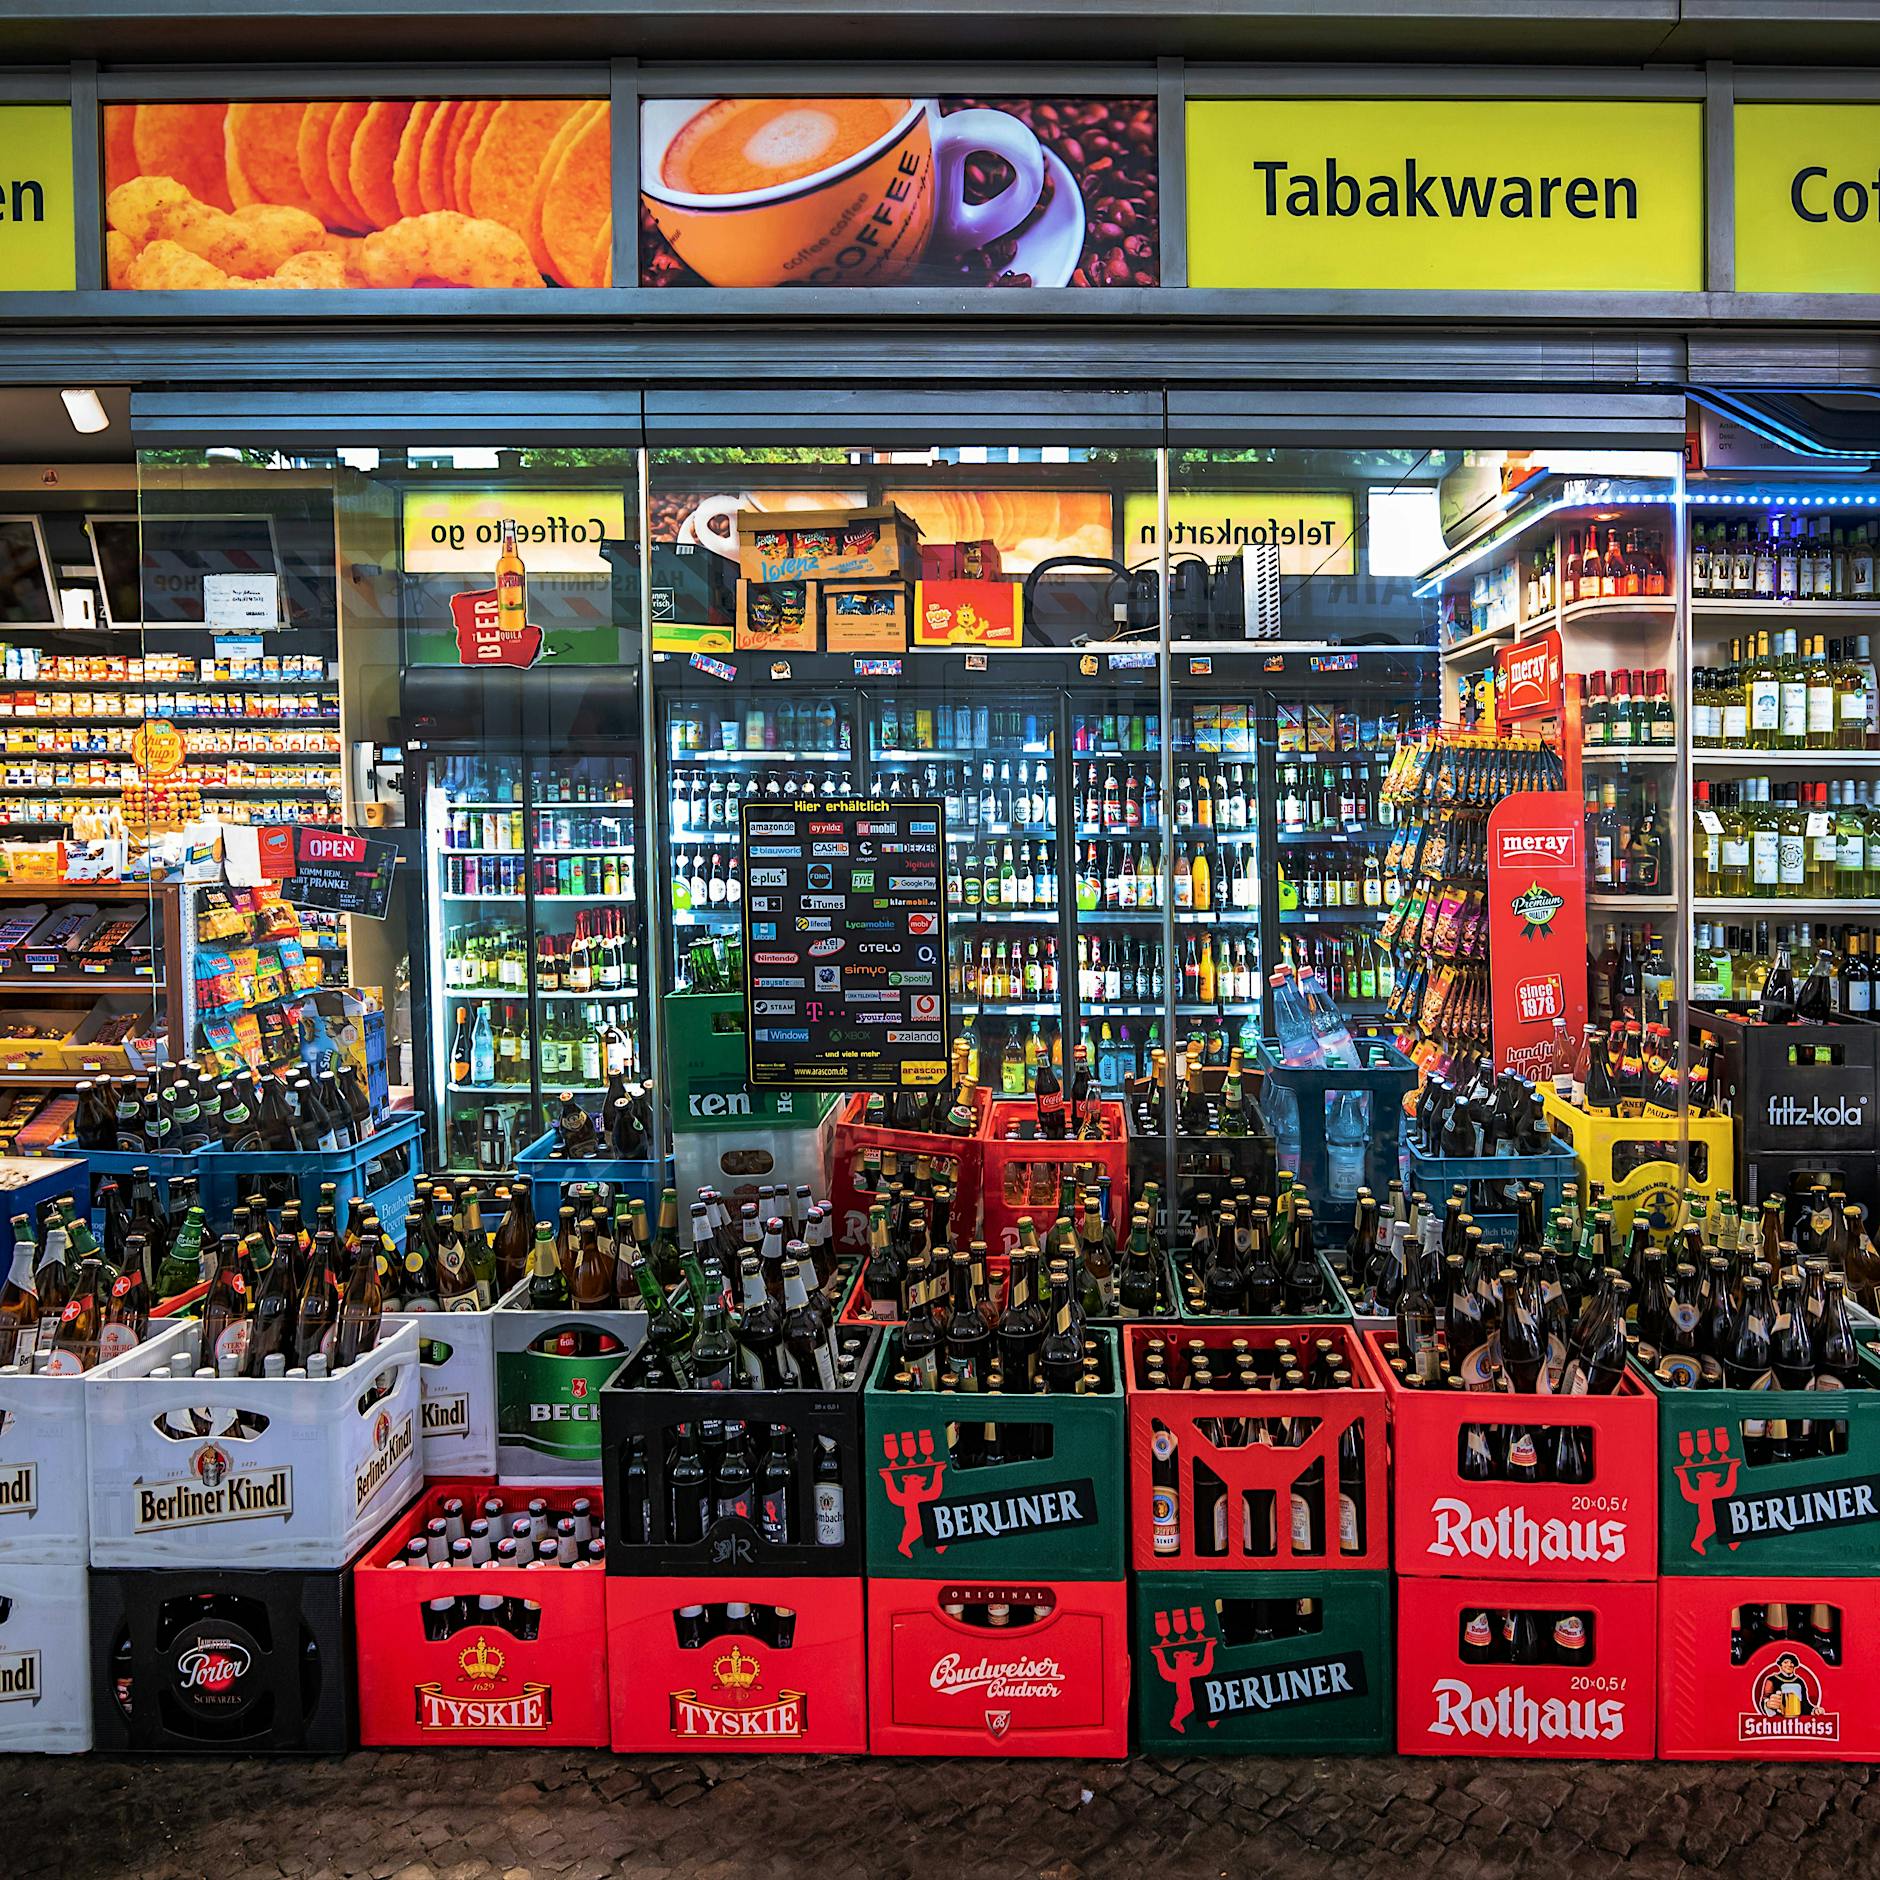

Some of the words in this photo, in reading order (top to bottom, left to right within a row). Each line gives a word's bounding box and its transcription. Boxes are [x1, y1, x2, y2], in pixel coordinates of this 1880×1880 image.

[1253, 158, 1638, 220] Tabakwaren
[761, 557, 820, 583] Lorenz
[651, 593, 669, 602] unny-
[652, 598, 671, 608] risch
[475, 599, 502, 659] BEER
[1510, 652, 1549, 684] meray
[794, 800, 821, 812] Hier
[826, 799, 890, 812] erhältlich
[310, 839, 355, 858] OPEN
[1502, 834, 1572, 855] meray
[299, 867, 323, 877] KOMM
[852, 874, 873, 888] FYVE
[309, 877, 350, 890] PRANKE!
[813, 899, 845, 910] iTunes
[1511, 894, 1565, 916] Premium
[845, 919, 896, 930] Lycamobile
[27, 954, 60, 963] SNICKERS
[757, 954, 796, 963] Nintendo
[844, 964, 887, 978] simyo
[903, 974, 932, 985] Spotify
[1519, 982, 1553, 1001] since
[769, 1003, 794, 1011] STEAM
[1521, 996, 1556, 1018] 1978
[770, 1030, 809, 1041] Windows
[899, 1030, 940, 1042] zalando
[825, 1050, 840, 1058] und
[841, 1050, 859, 1058] viele
[860, 1050, 881, 1058] mehr
[1506, 1040, 1554, 1064] handfu
[794, 1066, 848, 1077] www.arascom.de
[902, 1067, 946, 1075] arascom
[1767, 1095, 1863, 1127] fritz-kola
[421, 1399, 465, 1428] Kindl
[529, 1402, 602, 1422] BECK
[355, 1443, 390, 1504] Berliner
[388, 1420, 413, 1460] Kindl
[0, 1471, 31, 1505] ndl
[140, 1483, 225, 1524] Berliner
[227, 1472, 288, 1512] Kindl
[932, 1489, 1084, 1540] BERLINER
[1727, 1484, 1880, 1535] BERLINER
[1426, 1496, 1628, 1567] Rothaus
[951, 1589, 1046, 1602] ORIGINAL
[0, 1658, 36, 1693] ndl
[177, 1641, 252, 1689] Porter
[929, 1652, 1067, 1694] Budweiser
[471, 1681, 496, 1692] 1629
[986, 1679, 1063, 1700] Budvar
[1204, 1662, 1355, 1715] BERLINER
[193, 1693, 242, 1705] SCHWARZES
[423, 1693, 544, 1728] TYSKIE
[678, 1700, 800, 1736] TYSKIE
[1426, 1677, 1626, 1746] Rothaus
[1743, 1716, 1834, 1737] Schultheiss
